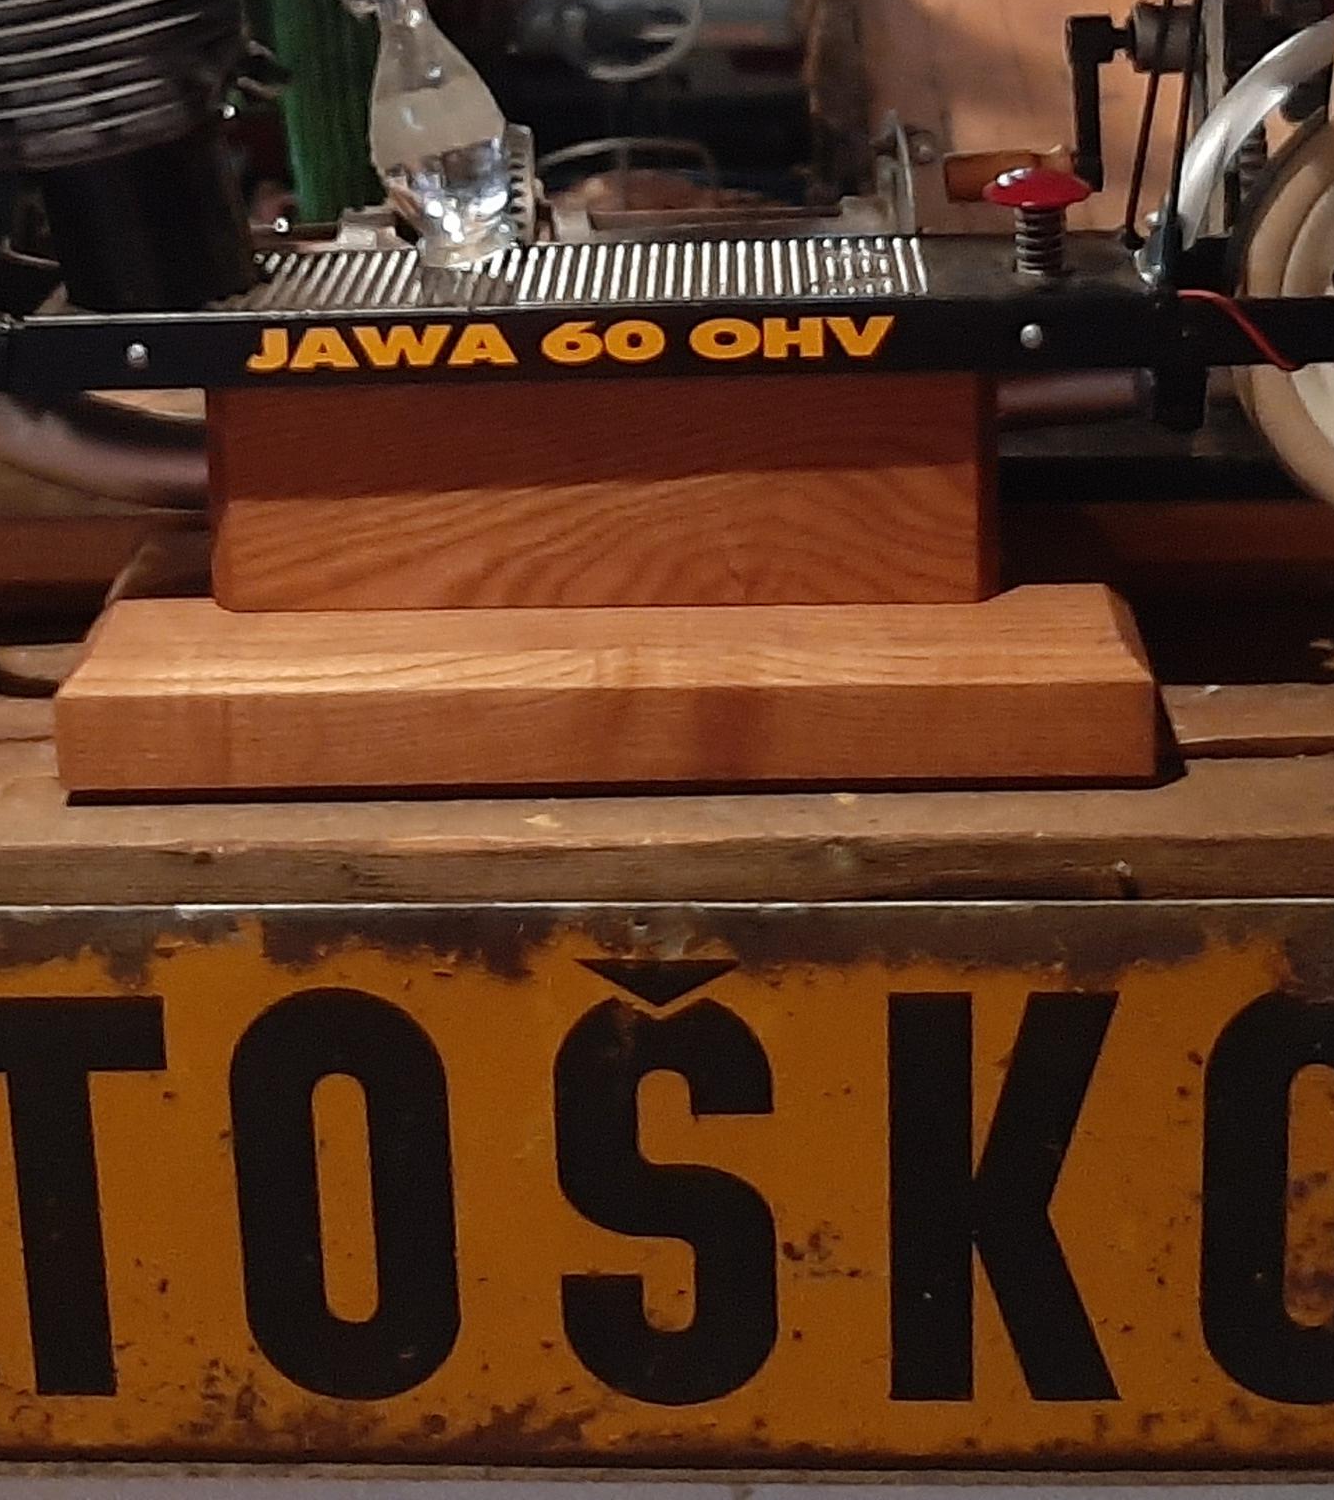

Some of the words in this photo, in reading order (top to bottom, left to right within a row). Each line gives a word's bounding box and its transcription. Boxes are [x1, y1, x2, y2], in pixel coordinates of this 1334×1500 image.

[246, 324, 518, 372] JAWA
[540, 319, 665, 364] 60
[689, 315, 895, 360] OHV
